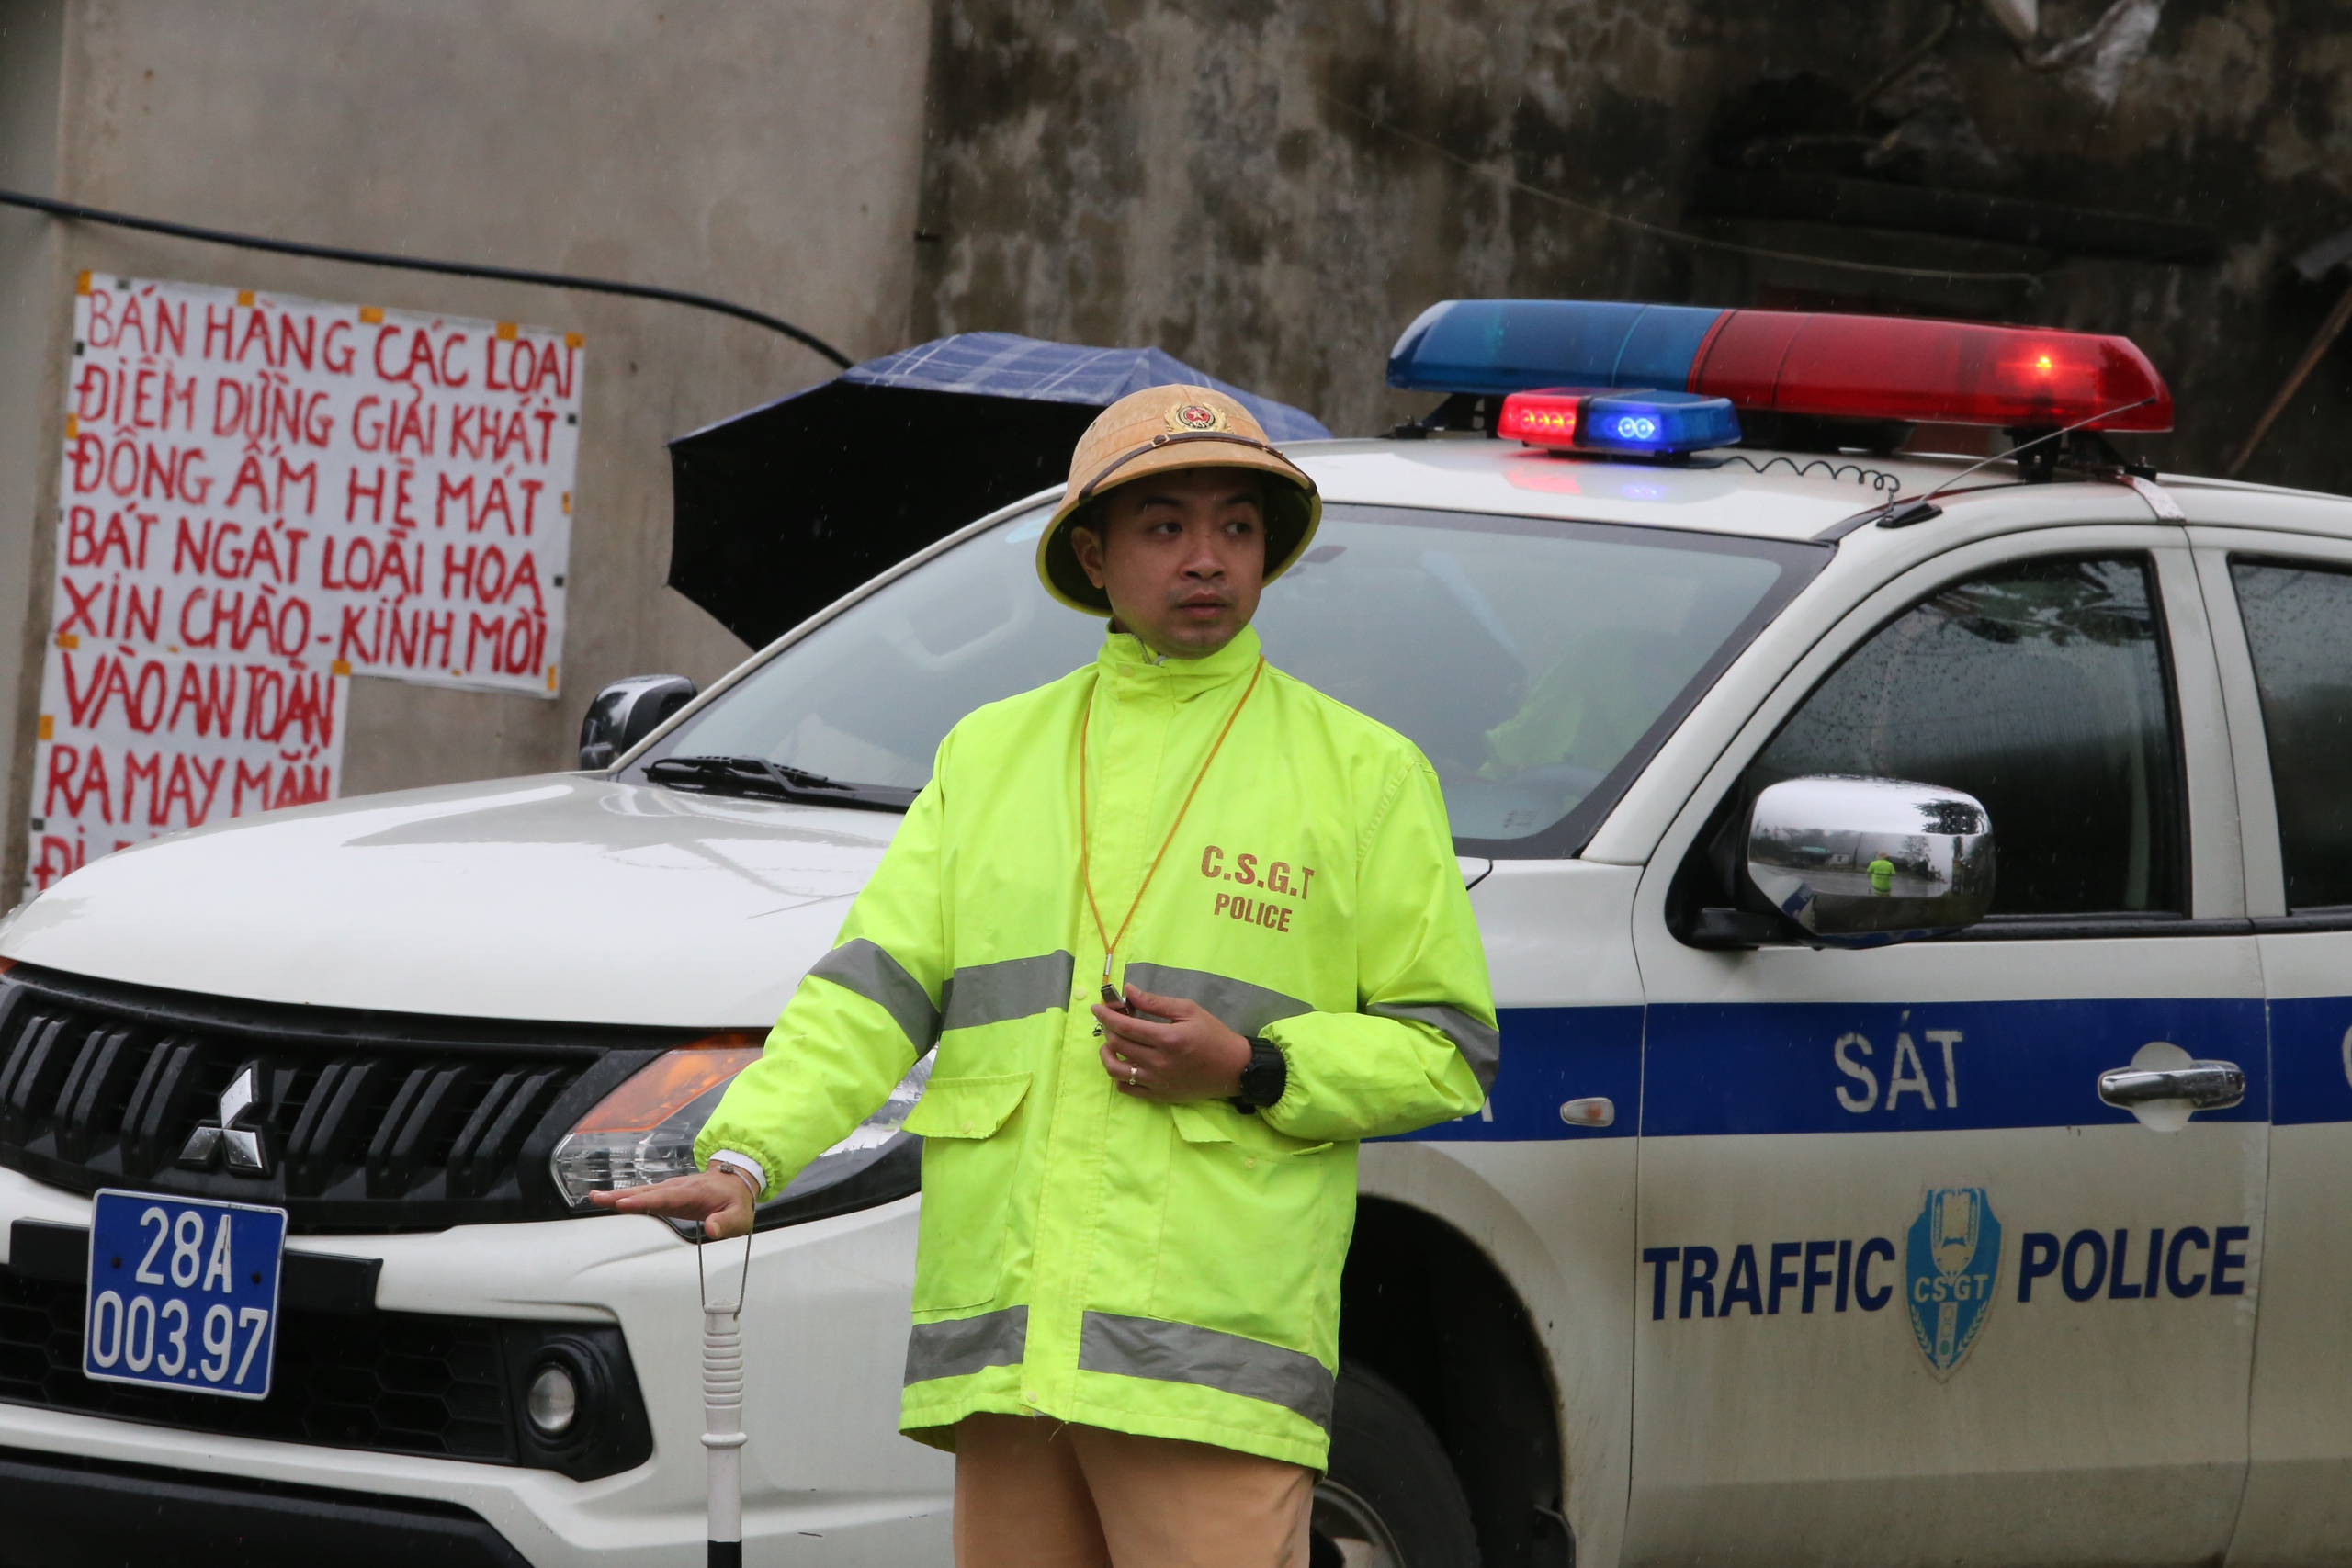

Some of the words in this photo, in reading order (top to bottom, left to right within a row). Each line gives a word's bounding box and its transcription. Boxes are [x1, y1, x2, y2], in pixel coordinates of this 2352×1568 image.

[88, 285, 187, 357] BÁN
[204, 298, 356, 377] HÀNG
[374, 320, 469, 388] CÁC
[352, 381, 436, 456] GIẢI
[449, 396, 558, 465] KHÁT
[65, 424, 214, 505] ĐÔNG
[224, 439, 317, 516] ẤM
[435, 462, 545, 537] MÁT
[67, 502, 159, 571] BÁT
[172, 518, 310, 584] NGÁT
[322, 528, 424, 596] LOÀI
[441, 543, 545, 611] HOA
[57, 571, 164, 643] XIN
[62, 644, 167, 733] VÀO
[44, 744, 112, 825] RA
[121, 748, 226, 829] MAY
[1201, 845, 1315, 900] C.S.G.T
[1214, 893, 1293, 932] POLICE
[1834, 1010, 1964, 1113] SÁT
[135, 1207, 232, 1293] 28A
[1643, 1237, 1896, 1321] TRAFFIC
[2017, 1225, 2250, 1303] POLICE
[93, 1290, 268, 1385] 003.97
